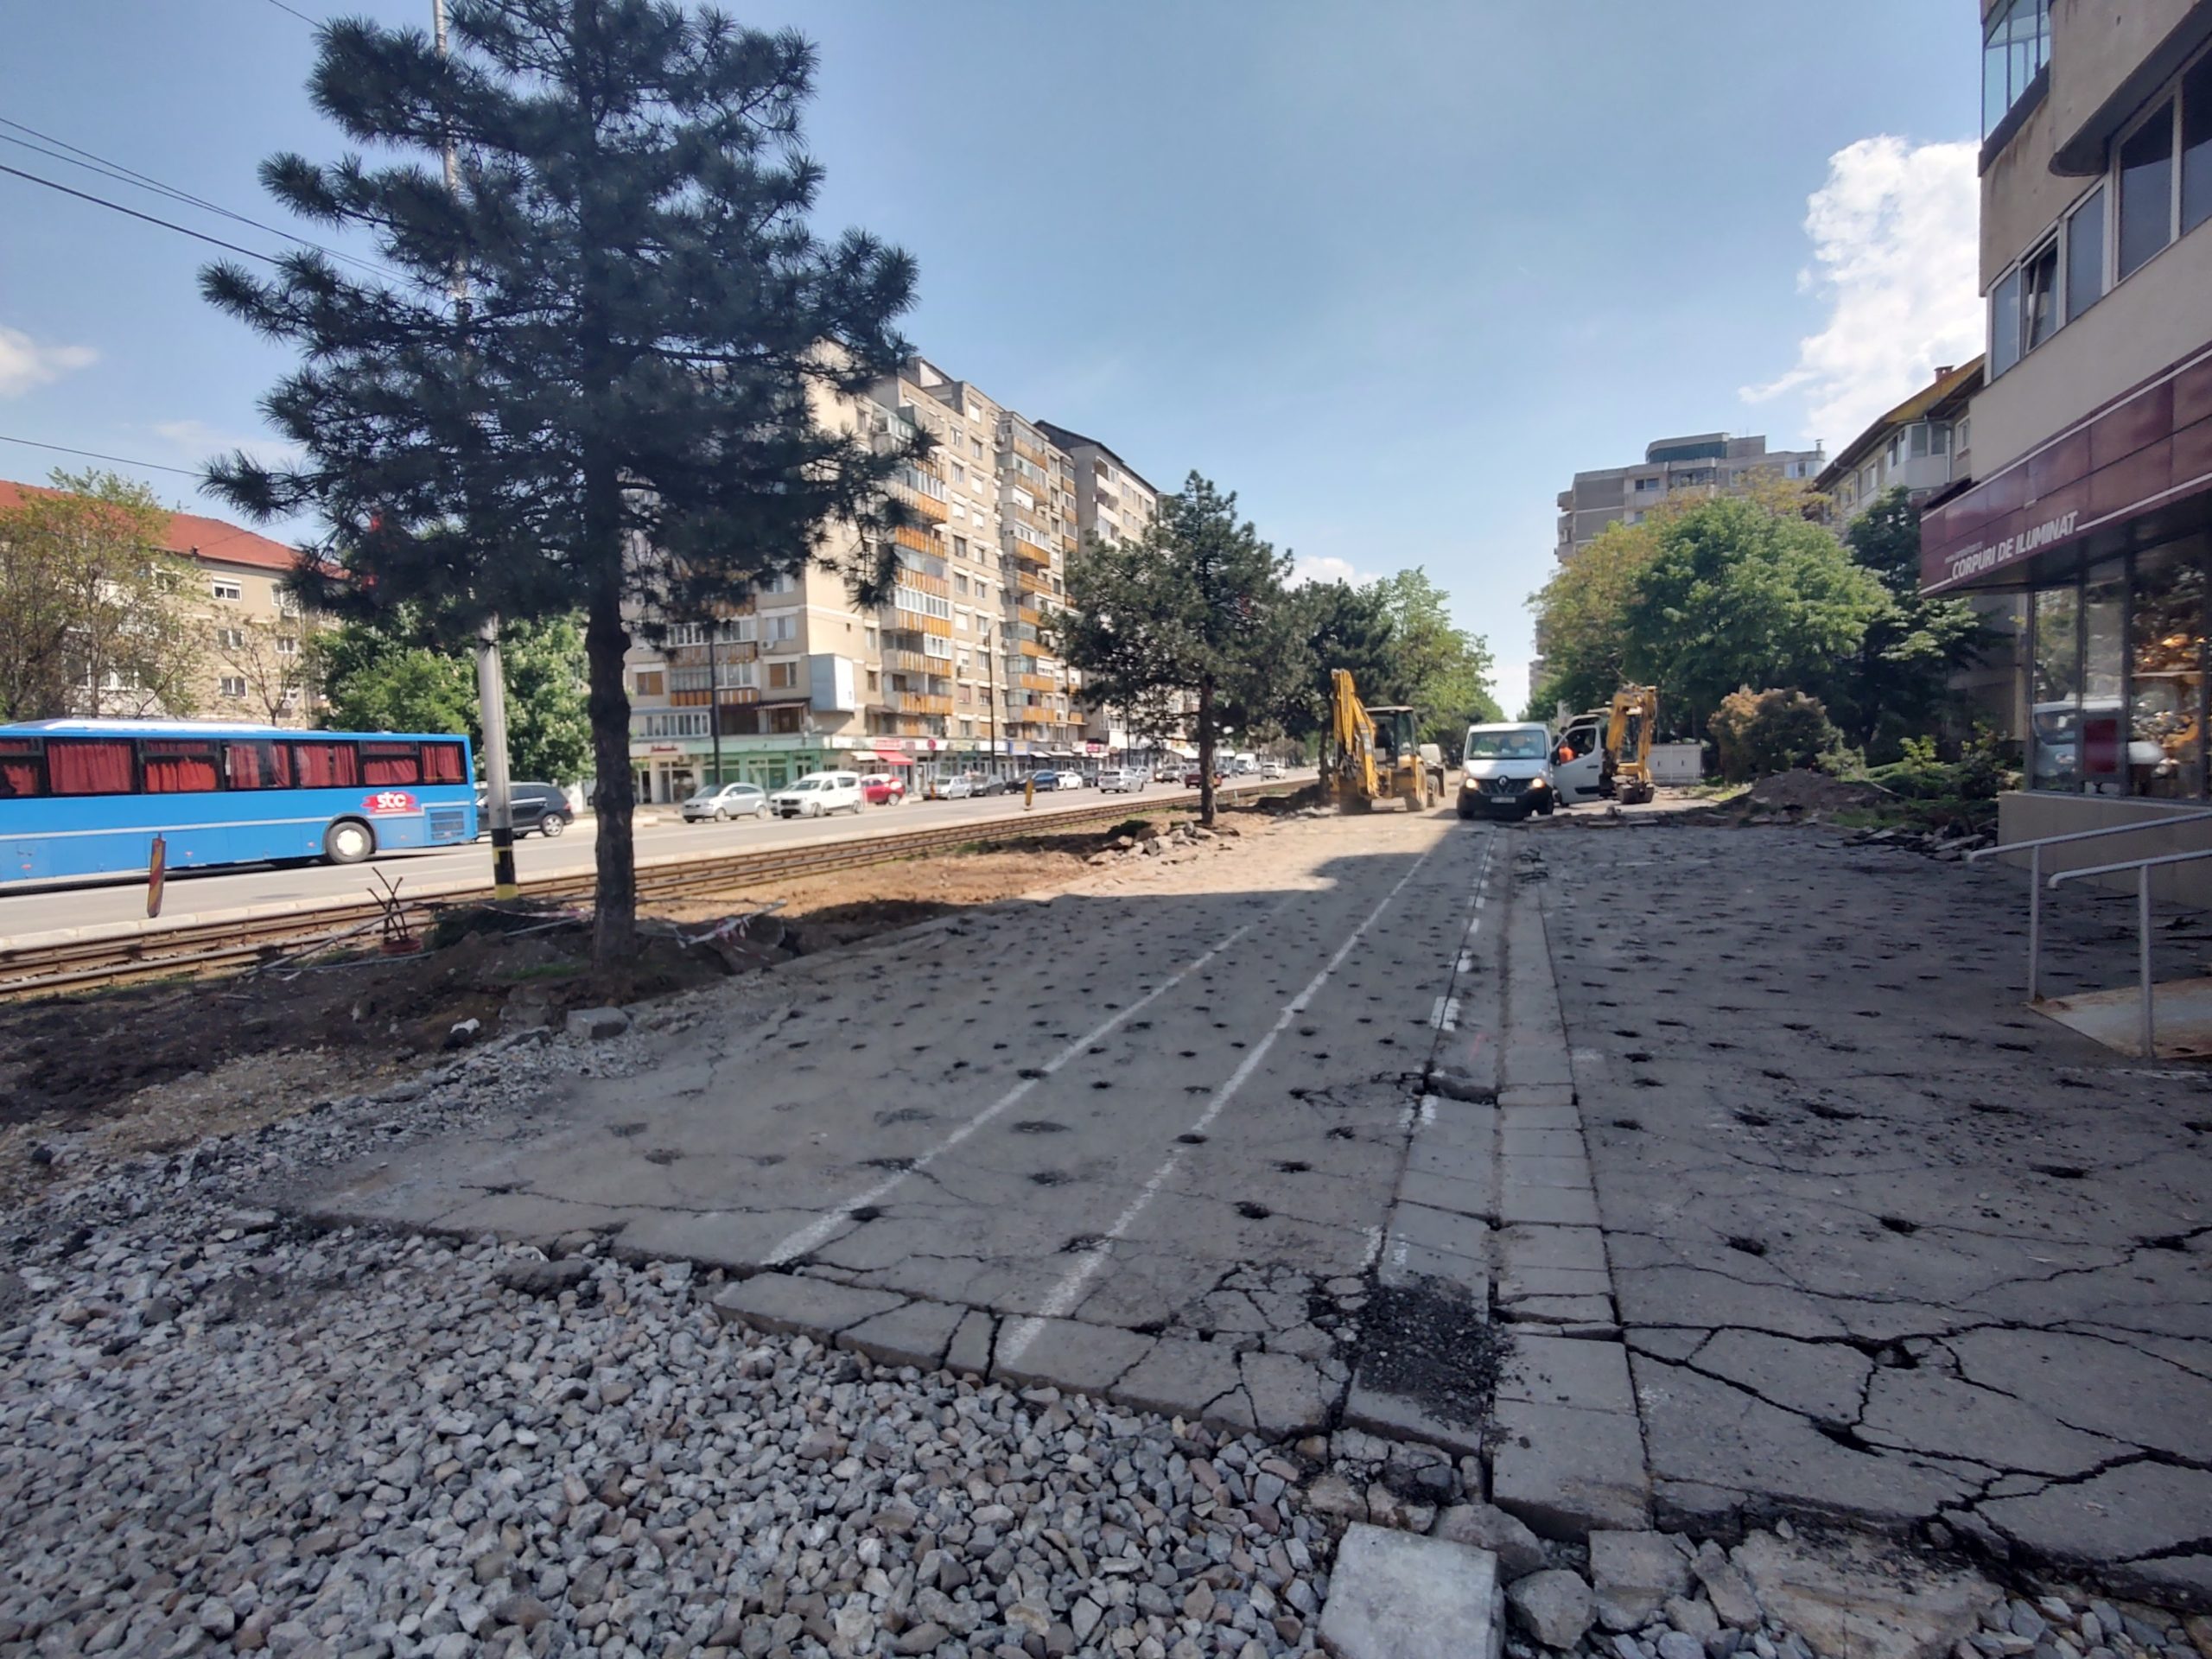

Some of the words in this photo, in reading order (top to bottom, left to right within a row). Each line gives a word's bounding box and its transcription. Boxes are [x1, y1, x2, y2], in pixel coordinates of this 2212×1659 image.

[1952, 545, 1996, 580] CORPURI
[1998, 537, 2014, 562] DE
[2016, 510, 2078, 555] ILUMINAT
